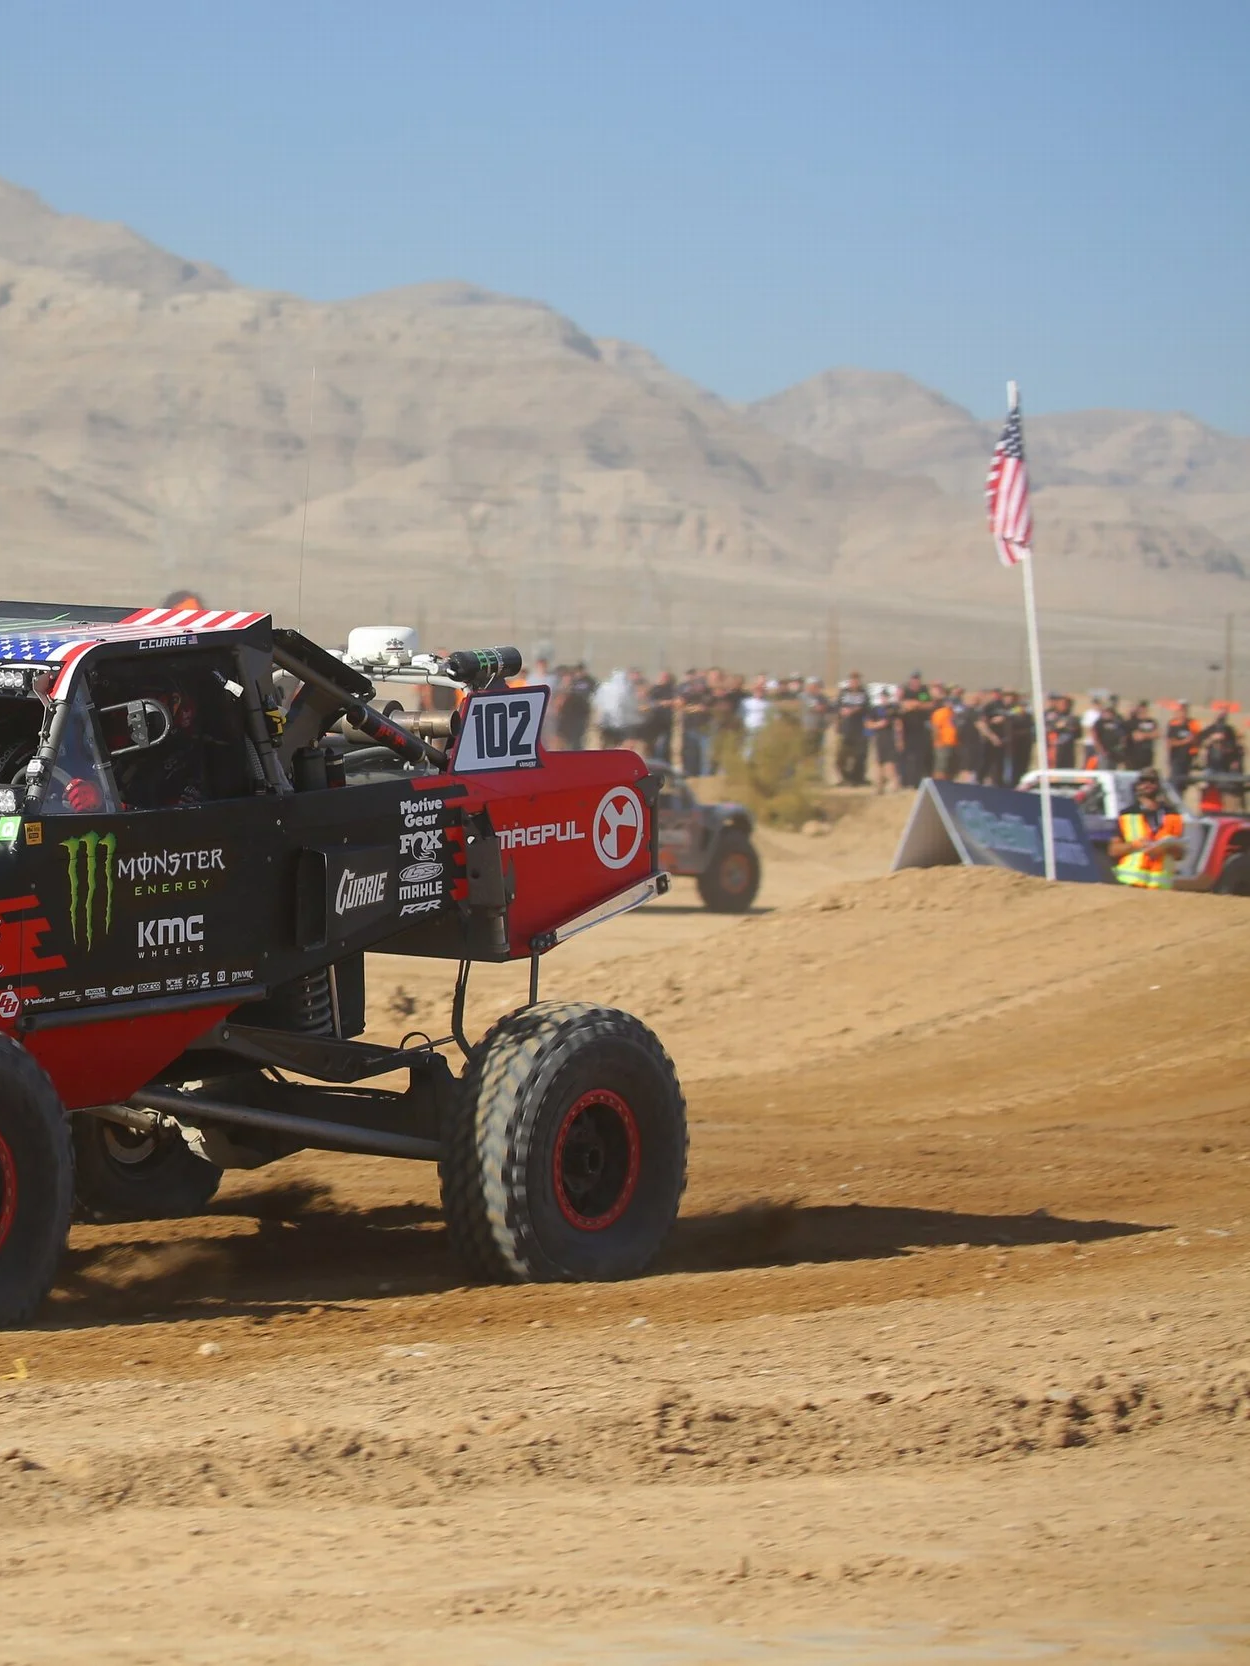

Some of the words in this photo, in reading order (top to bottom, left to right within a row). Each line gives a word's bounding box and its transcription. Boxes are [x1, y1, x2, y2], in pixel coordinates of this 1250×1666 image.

[139, 636, 187, 650] C.CURRIE
[472, 700, 532, 759] 102
[400, 797, 443, 815] Motive
[404, 813, 438, 828] Gear
[399, 829, 443, 861] FOX
[117, 848, 225, 881] MONSTER
[134, 879, 209, 896] ENERGY
[335, 868, 388, 916] CURRIE
[399, 881, 443, 900] MAHLE
[399, 899, 442, 917] RZR
[138, 914, 204, 948] KMC
[137, 944, 205, 959] WHEELS
